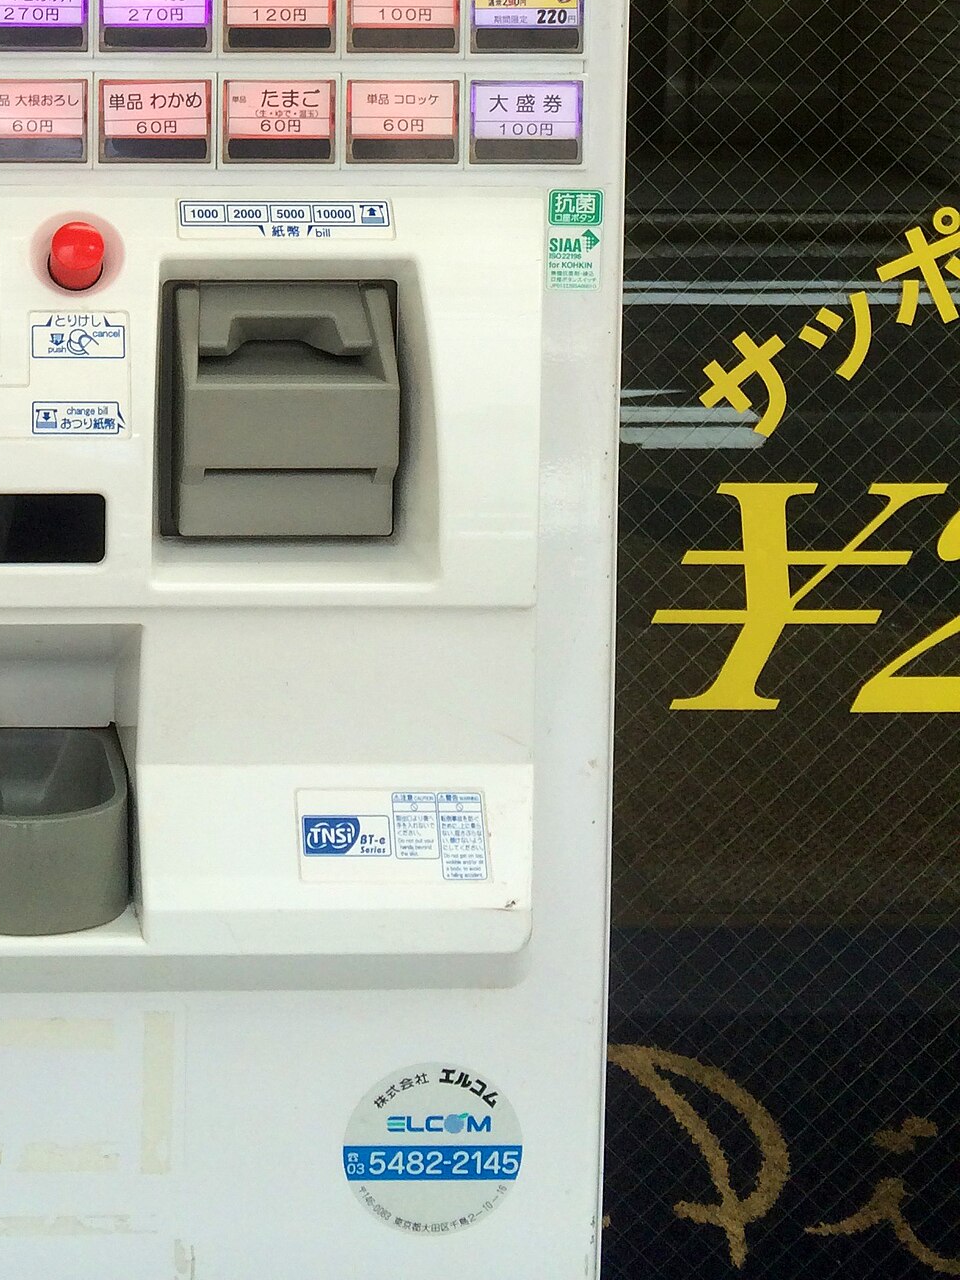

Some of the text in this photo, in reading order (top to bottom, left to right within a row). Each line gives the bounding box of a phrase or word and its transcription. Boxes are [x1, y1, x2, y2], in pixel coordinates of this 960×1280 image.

[253, 9, 306, 21] 120円
[379, 9, 431, 21] 100円
[15, 94, 79, 107] 大根おろし
[150, 92, 202, 109] わかめ
[262, 89, 320, 107] たまご
[395, 94, 439, 105] コロッケ
[489, 94, 562, 113] 大盛券
[137, 121, 177, 133] 60円
[500, 123, 553, 136] 100円
[555, 194, 595, 213] 抗菌
[190, 209, 351, 219] 1000 2000 5000 10000
[272, 225, 330, 238] 紙幣 bill
[549, 238, 581, 252] SIAA
[55, 315, 101, 327] とりけし
[93, 329, 120, 337] cancel
[67, 407, 95, 416] change
[61, 418, 115, 429] おつり紙幣
[310, 827, 352, 844] TNSi
[361, 846, 385, 854] Series
[374, 1069, 499, 1109] 株式会社 エルコム
[348, 1151, 518, 1174] 03 5482-2145
